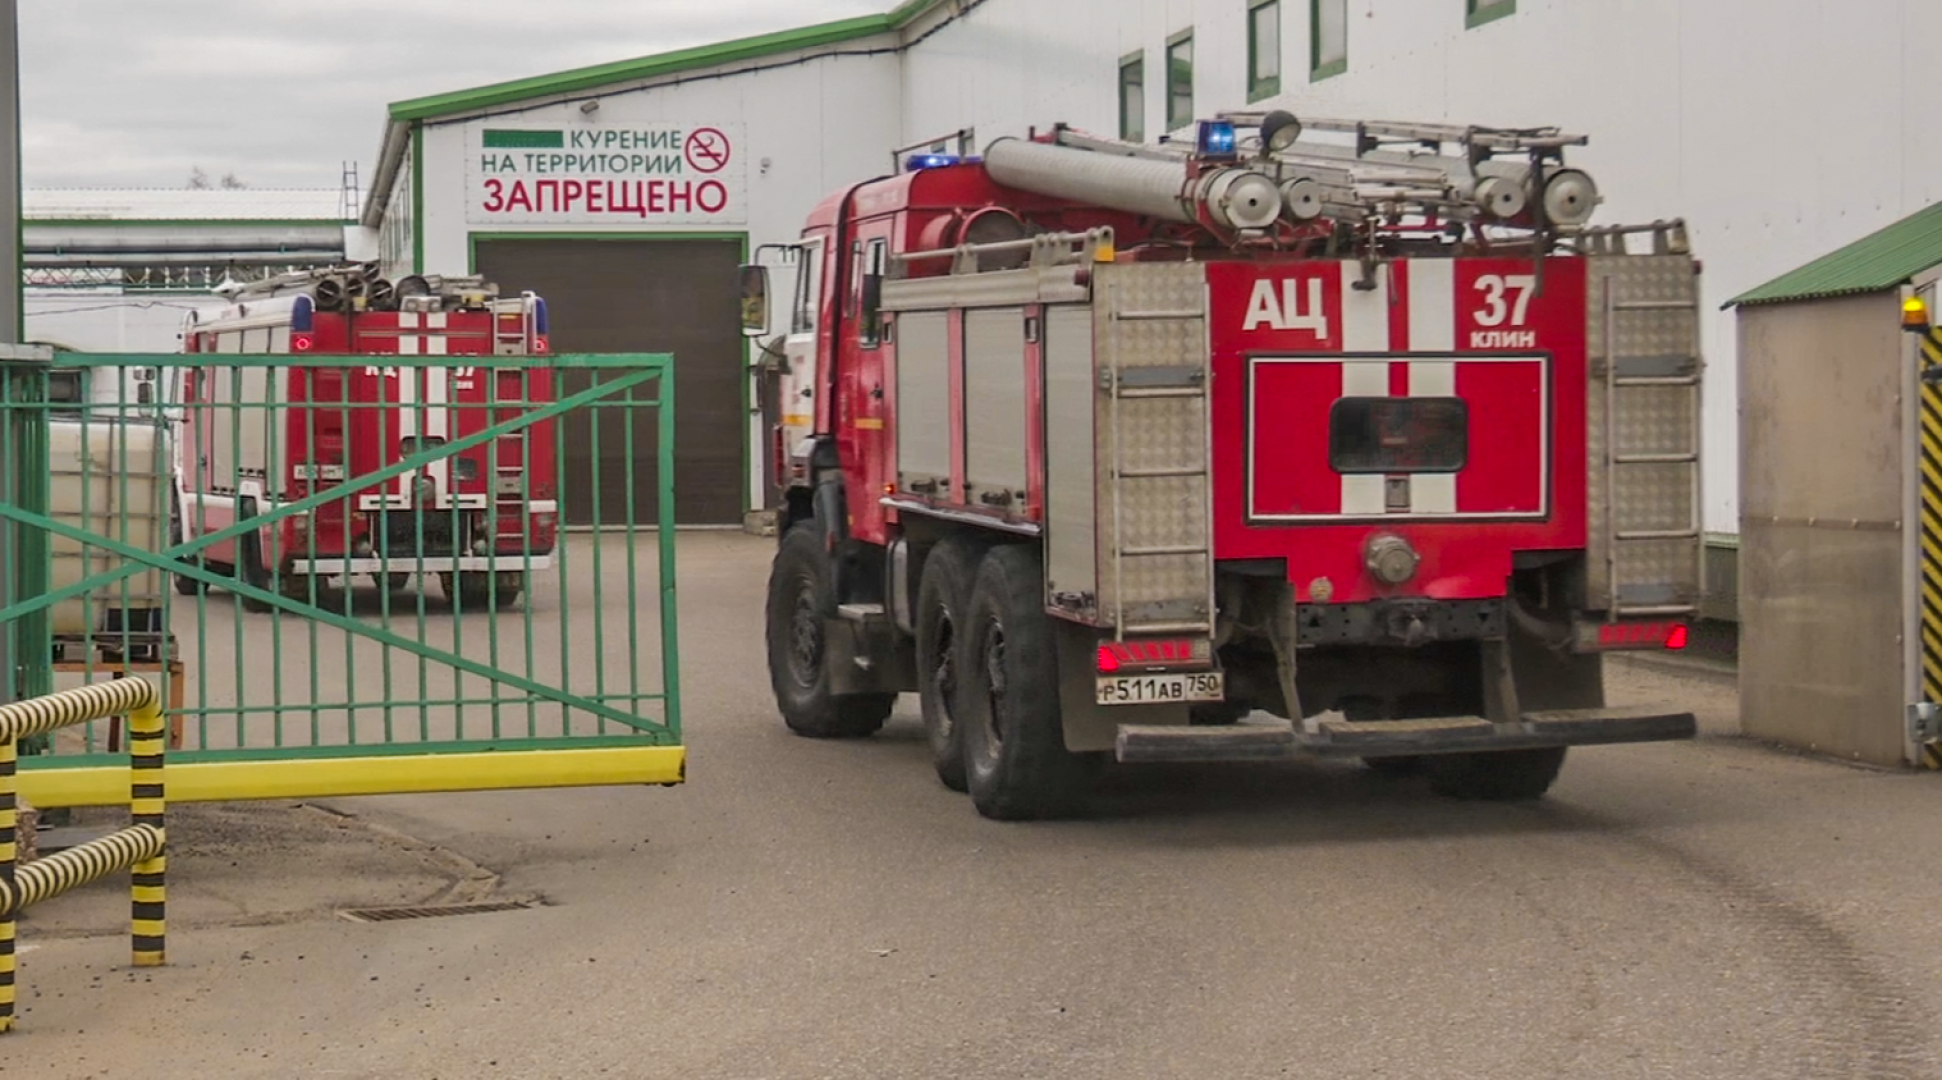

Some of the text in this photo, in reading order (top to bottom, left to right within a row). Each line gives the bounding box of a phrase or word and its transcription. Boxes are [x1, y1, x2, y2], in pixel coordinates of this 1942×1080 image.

[571, 130, 682, 149] КУРЕНИЕ
[482, 154, 682, 174] НА ТЕРРИТОРИИ
[483, 178, 728, 218] ЗАПРЕЩЕНО
[1242, 278, 1328, 340] АЦ
[1473, 274, 1536, 326] 37
[1470, 331, 1535, 348] КЛИН
